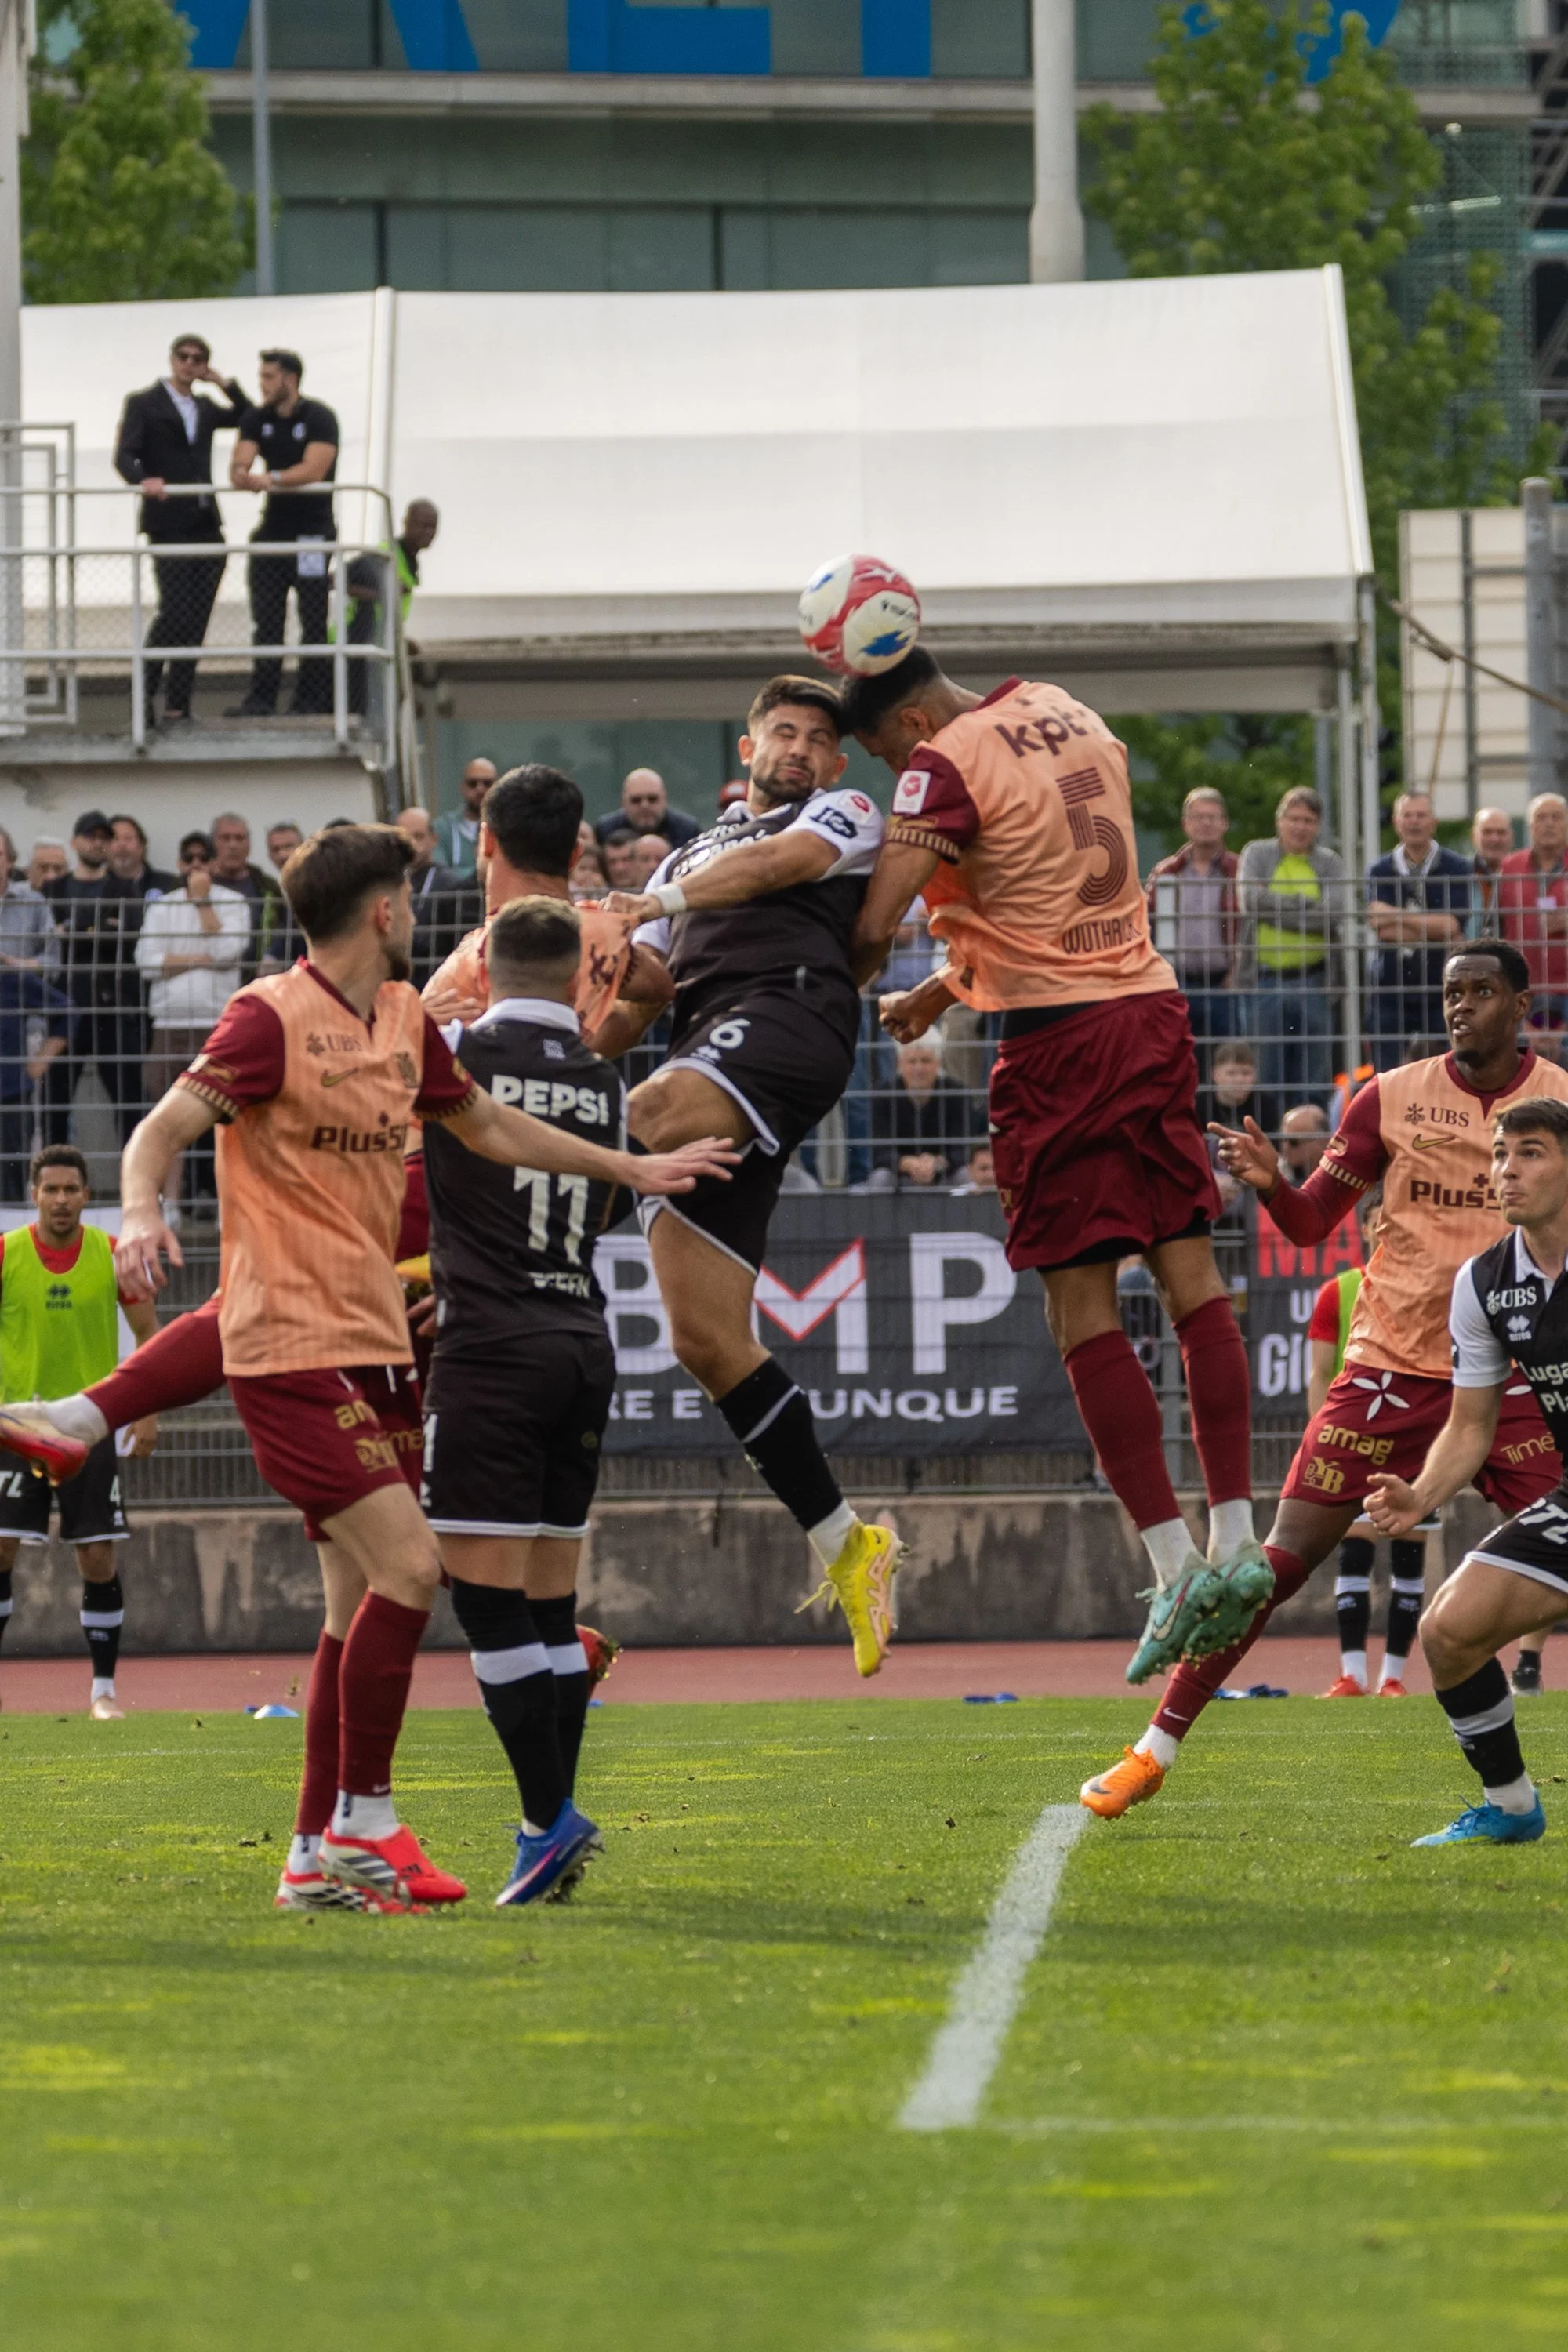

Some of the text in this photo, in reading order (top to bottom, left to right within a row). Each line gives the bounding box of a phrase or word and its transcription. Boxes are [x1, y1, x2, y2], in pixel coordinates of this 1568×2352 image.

[1055, 766, 1129, 906] 5
[709, 1018, 751, 1049] 6
[491, 1074, 609, 1126] PEPSI
[1430, 1106, 1469, 1127] UBS
[513, 1165, 589, 1265] 11
[1501, 1286, 1537, 1308] UBS
[808, 1385, 1019, 1422] UNQUE
[1317, 1423, 1395, 1466] amag
